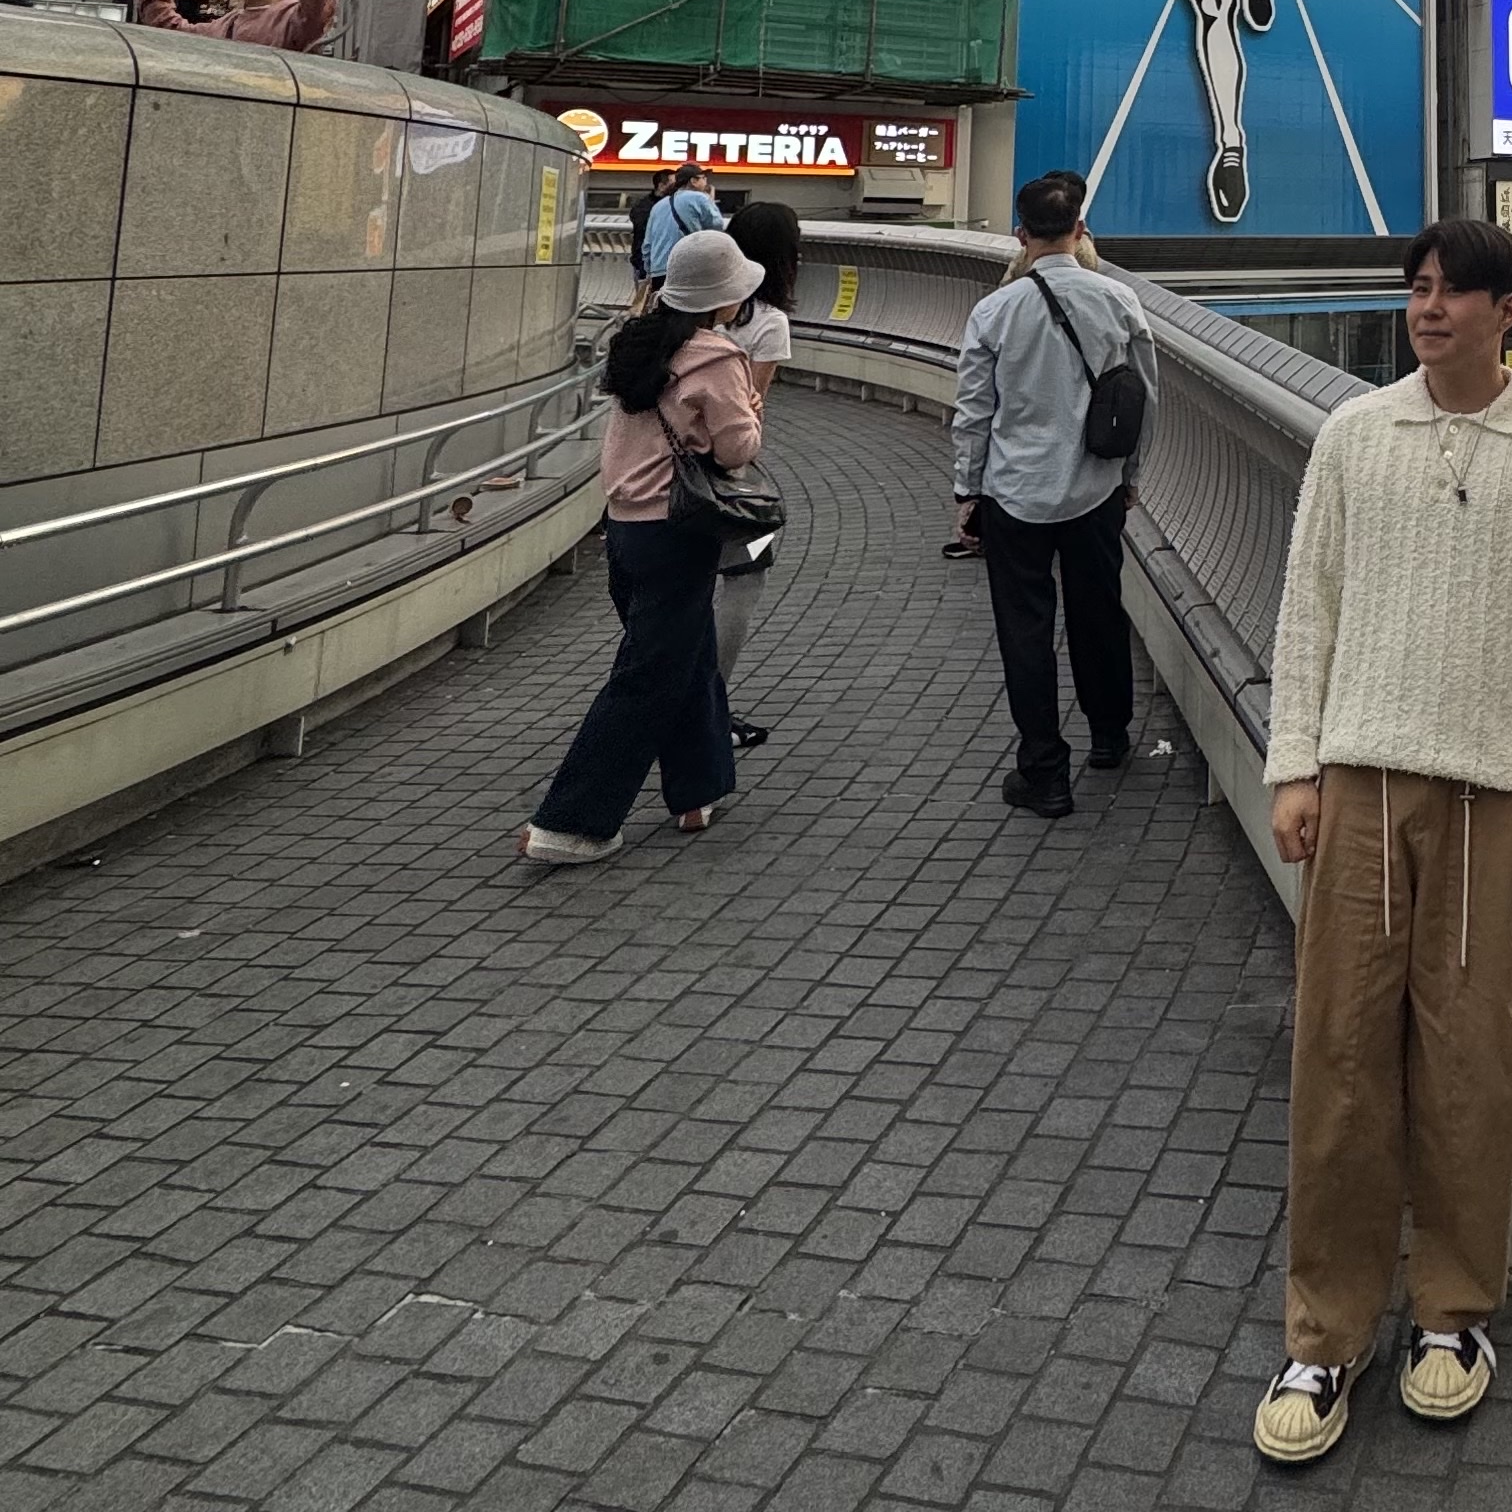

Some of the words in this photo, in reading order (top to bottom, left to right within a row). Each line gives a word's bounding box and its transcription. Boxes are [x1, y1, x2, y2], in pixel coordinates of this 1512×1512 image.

[618, 120, 848, 166] ZETTERIA
[895, 152, 938, 162] コーヒー
